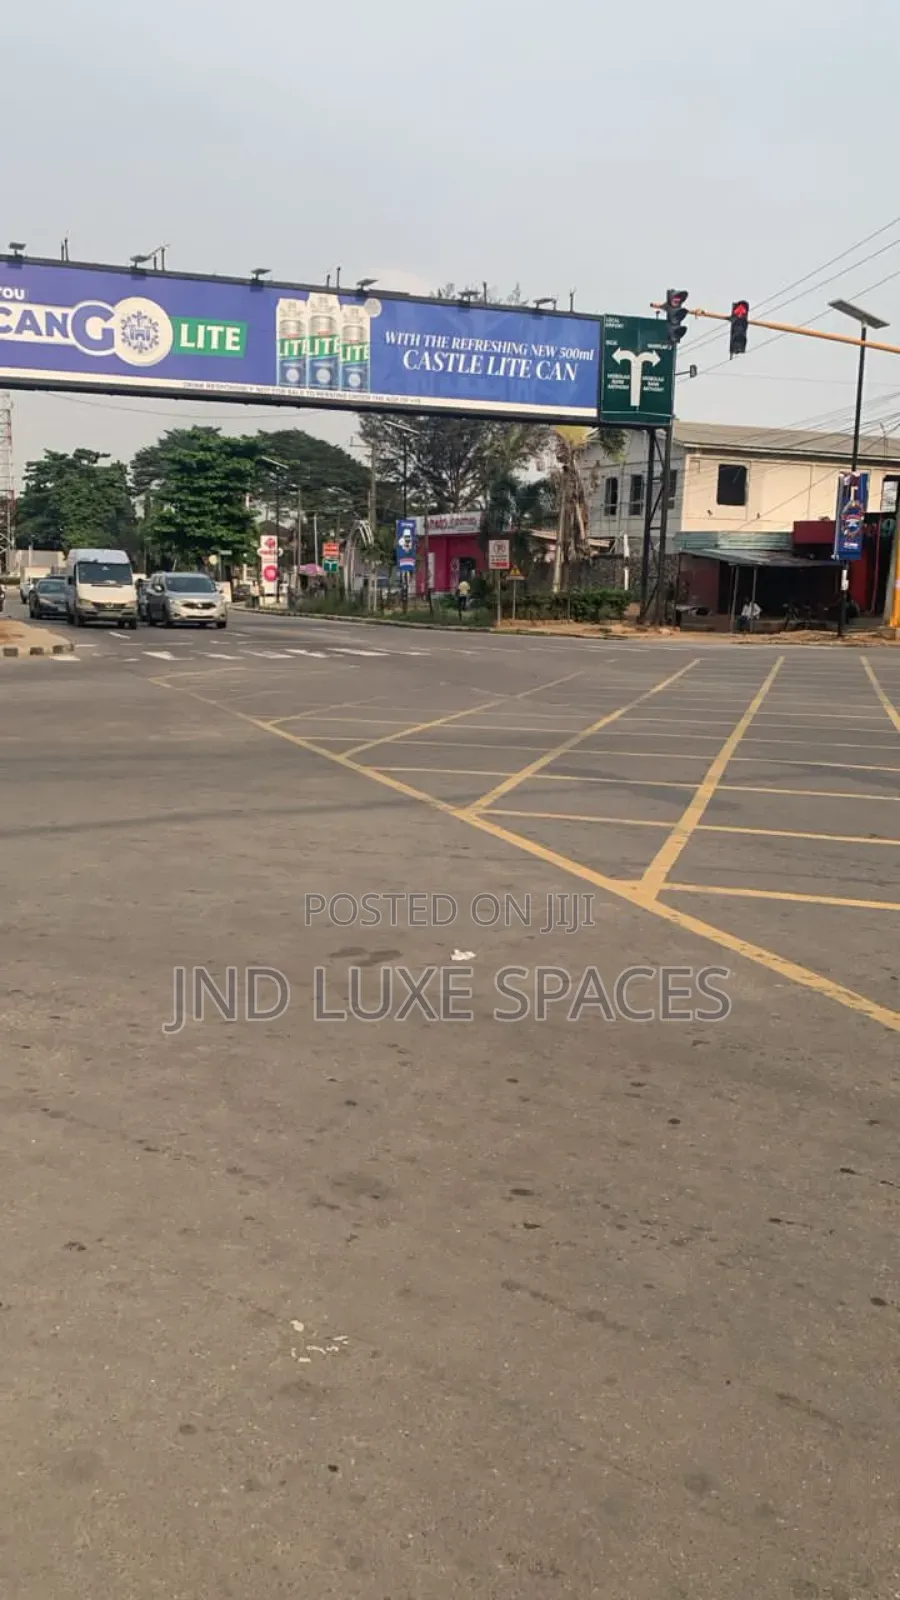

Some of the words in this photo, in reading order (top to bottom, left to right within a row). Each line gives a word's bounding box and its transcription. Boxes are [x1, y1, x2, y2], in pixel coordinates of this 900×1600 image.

[179, 322, 241, 351] LITE
[385, 331, 421, 347] WITH
[423, 334, 450, 349] THE
[451, 336, 528, 356] REFRESHING
[531, 344, 558, 358] NEW
[559, 346, 595, 361] 500ml
[403, 349, 484, 375] CASTLE
[487, 355, 532, 378] LITE
[536, 360, 579, 381] CAN
